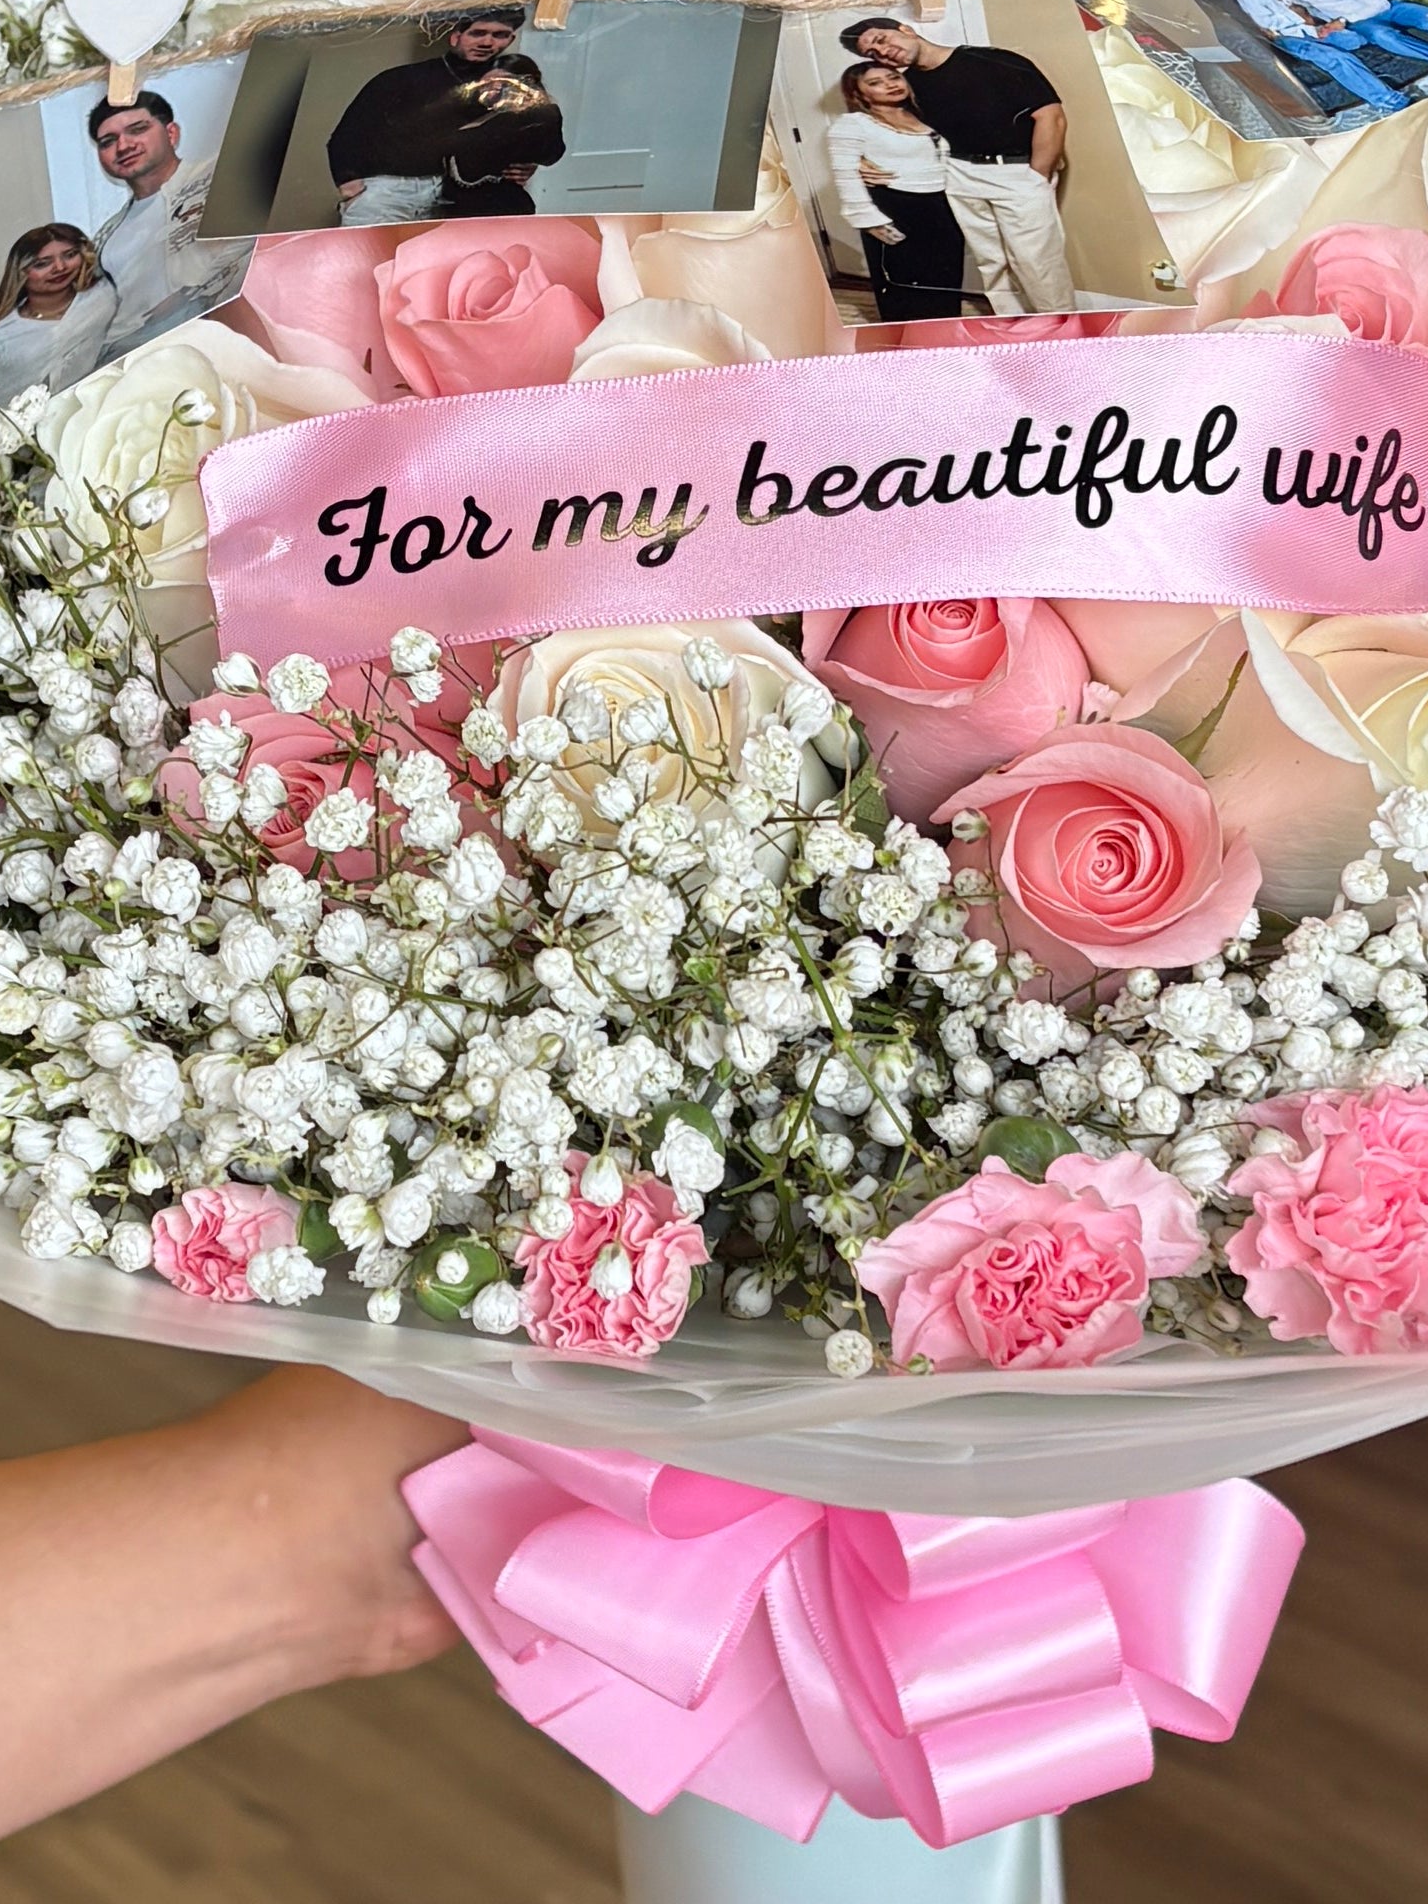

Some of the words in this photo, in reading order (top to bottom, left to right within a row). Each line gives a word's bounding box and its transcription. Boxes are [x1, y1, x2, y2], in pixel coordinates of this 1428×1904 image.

[318, 485, 513, 587] For
[532, 482, 711, 568] my
[736, 404, 1241, 529] beautiful
[1261, 427, 1427, 561] wife
